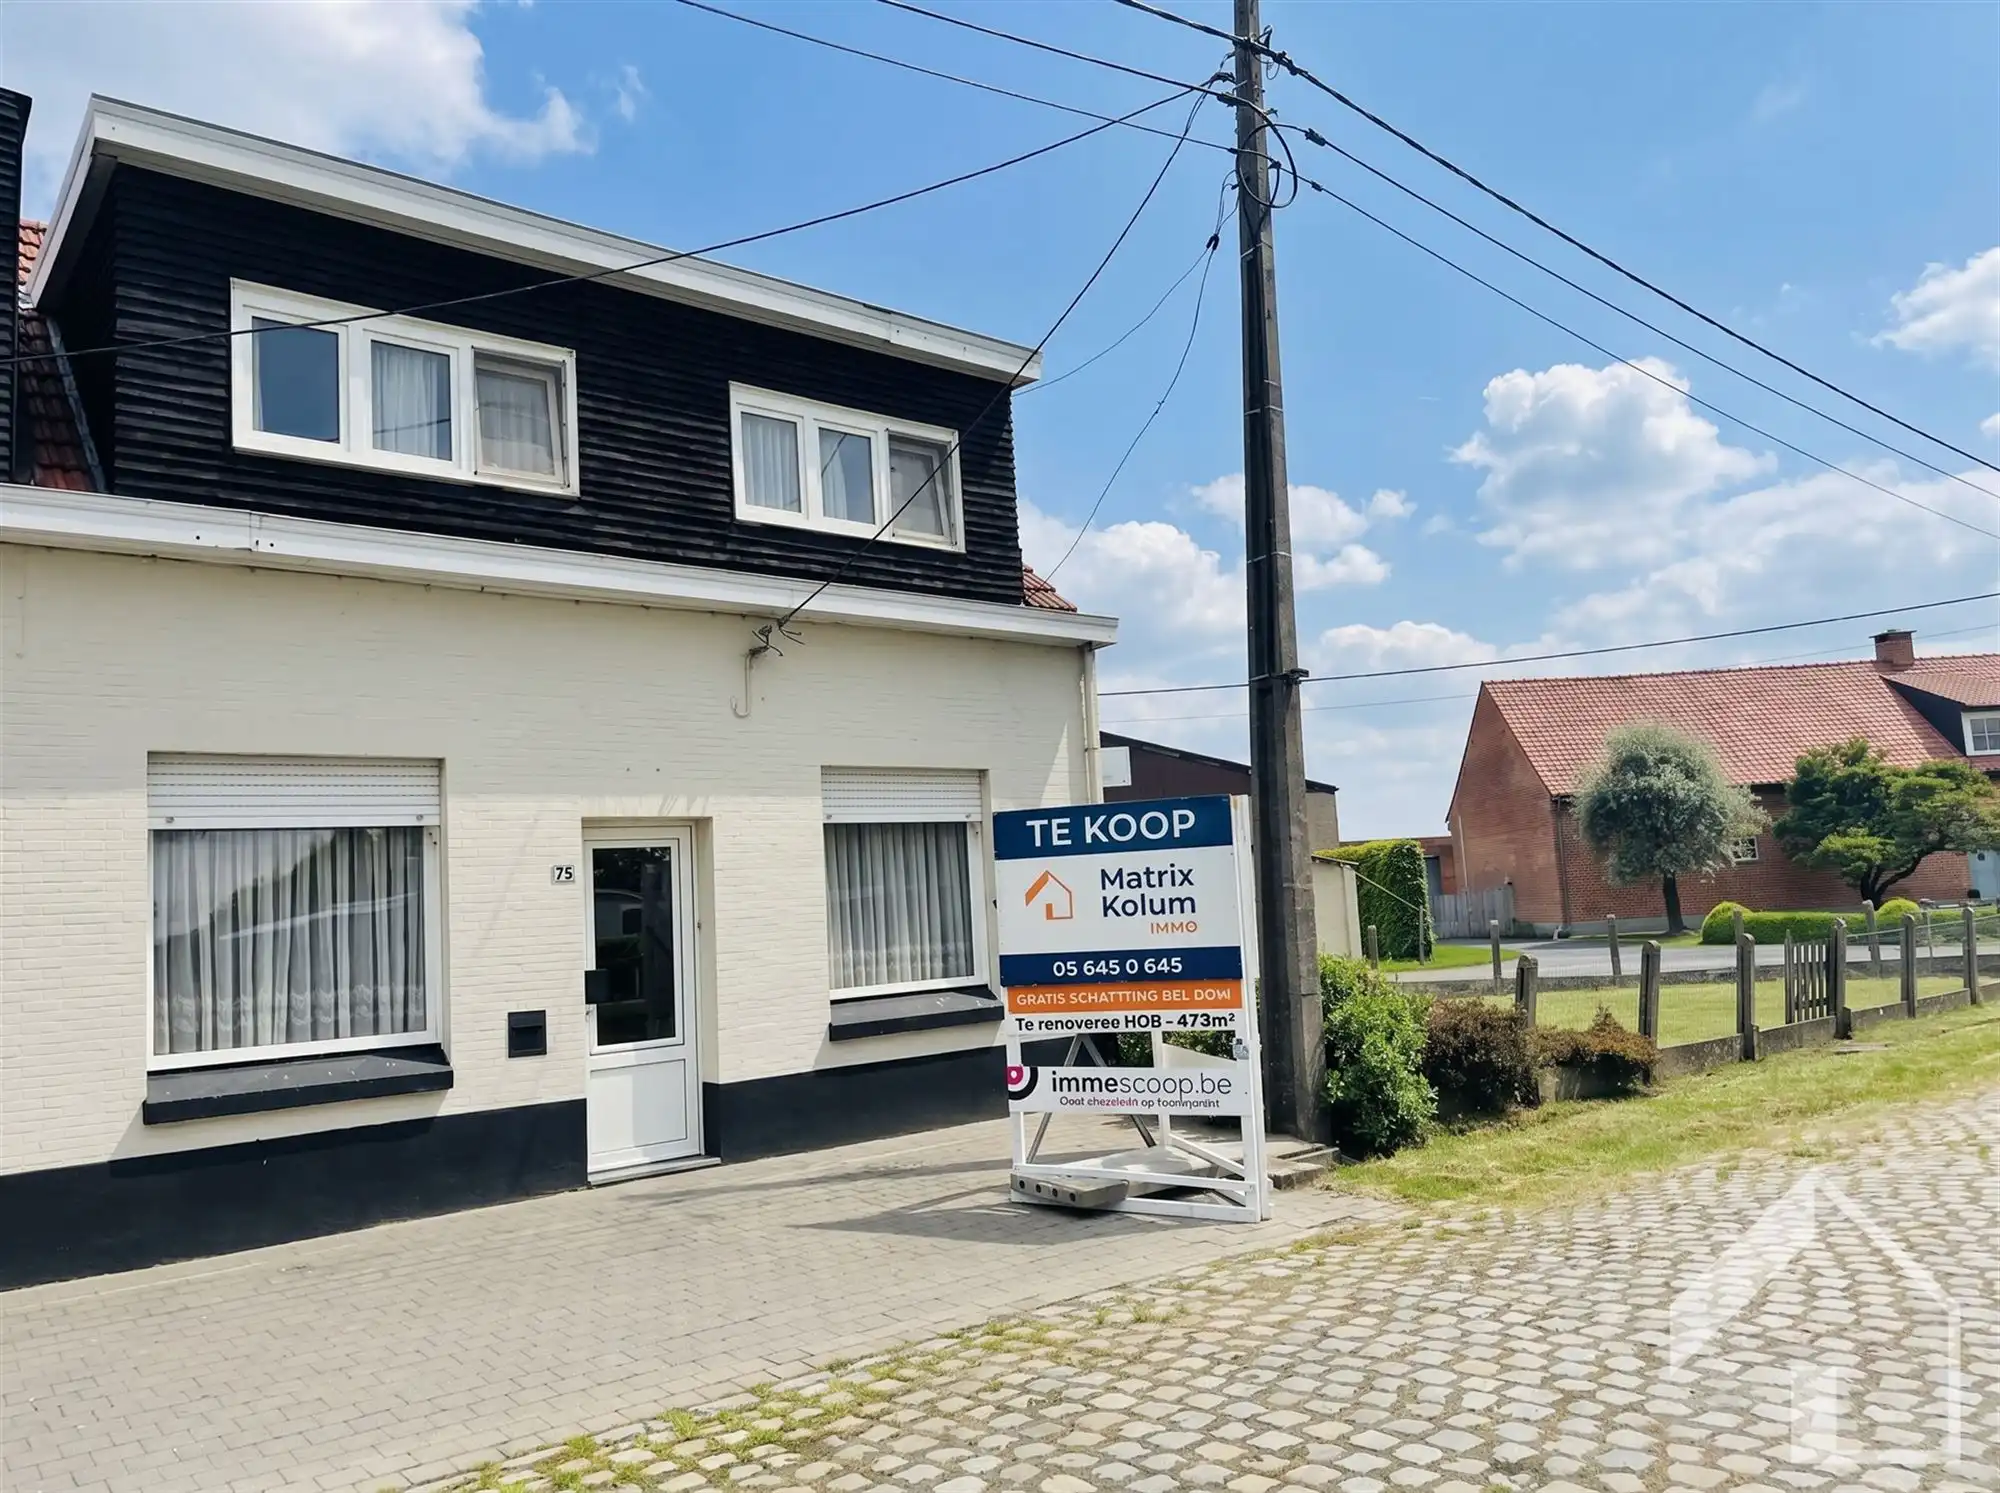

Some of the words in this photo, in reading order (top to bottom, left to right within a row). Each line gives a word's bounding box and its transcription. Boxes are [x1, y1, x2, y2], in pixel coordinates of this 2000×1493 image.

[1026, 818, 1072, 847] TE
[1084, 809, 1196, 844] KOOP
[556, 867, 573, 880] 75
[1100, 863, 1195, 891] Matrix
[1102, 893, 1196, 918] Kolum
[1150, 920, 1198, 934] IMMO
[1053, 960, 1078, 977] 05
[1083, 959, 1121, 976] 645
[1125, 958, 1139, 975] 0
[1143, 957, 1183, 974] 645
[1016, 992, 1066, 1006] GRATIS
[1162, 988, 1190, 1002] BEL
[1015, 1017, 1035, 1031] Te
[1038, 1017, 1120, 1031] renoveree
[1124, 1013, 1162, 1029] HOB
[1052, 1070, 1233, 1102] immescoop.be
[1141, 1099, 1155, 1109] op
